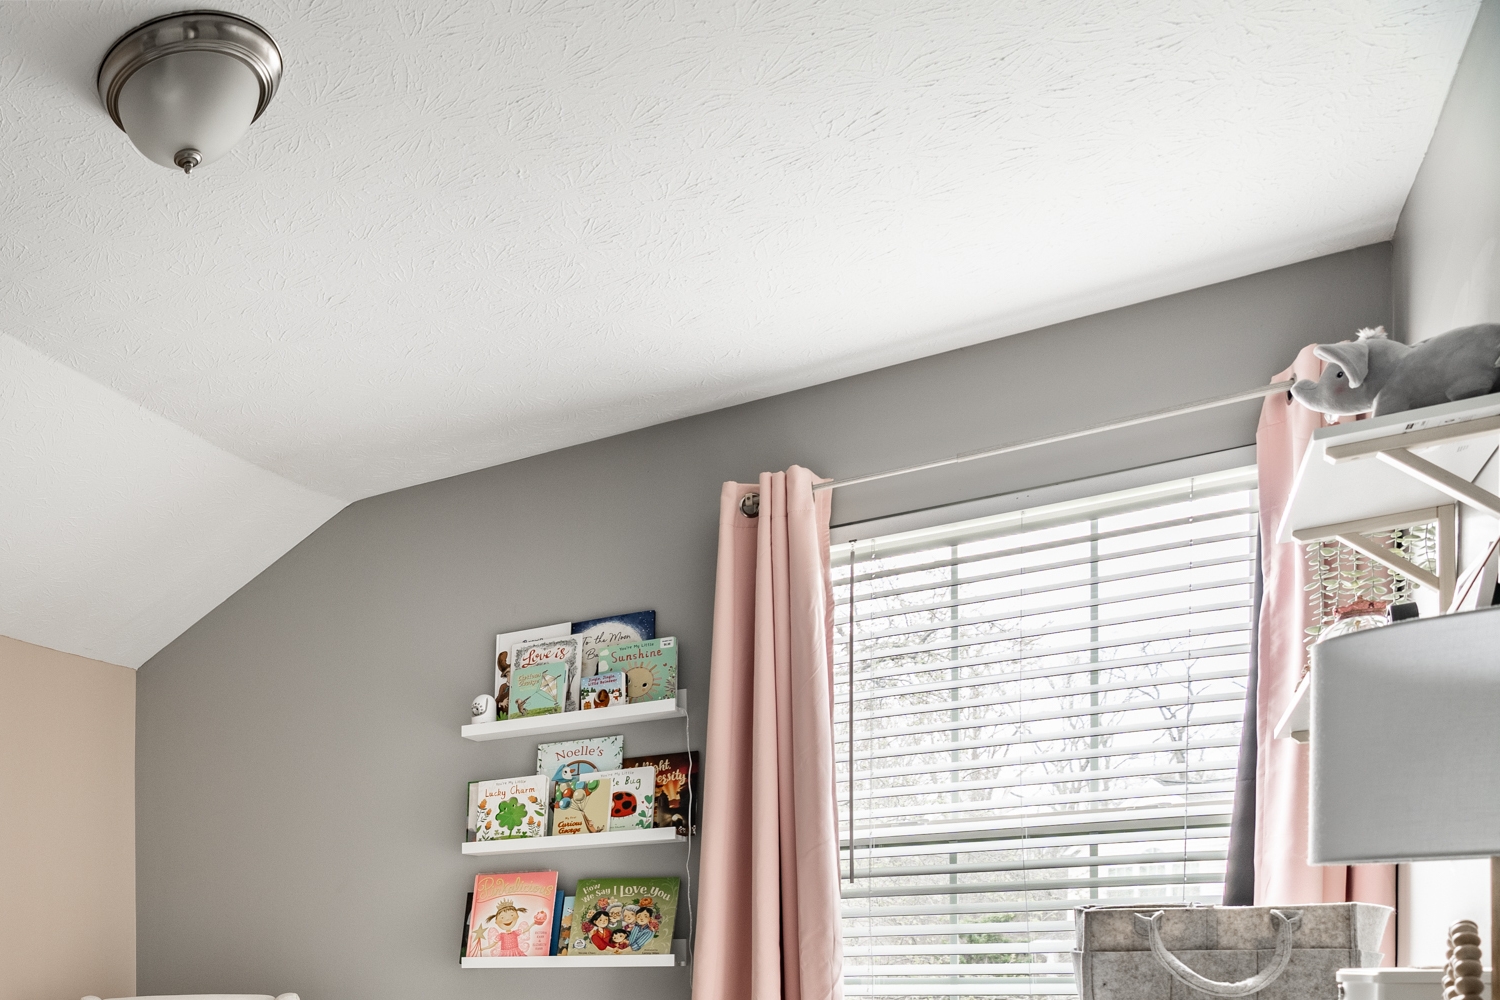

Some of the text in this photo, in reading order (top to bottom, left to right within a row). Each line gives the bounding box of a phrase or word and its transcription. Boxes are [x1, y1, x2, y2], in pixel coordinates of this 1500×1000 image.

[582, 632, 631, 647] To the Moon
[521, 649, 553, 668] Love
[611, 648, 663, 664] Sunshine
[555, 745, 604, 761] Noelle's
[624, 776, 641, 790] Bug
[485, 784, 536, 800] Lucky Charm
[477, 876, 554, 899] Pinkalicious
[581, 885, 671, 903] We Say I Love You
[582, 883, 601, 894] How
